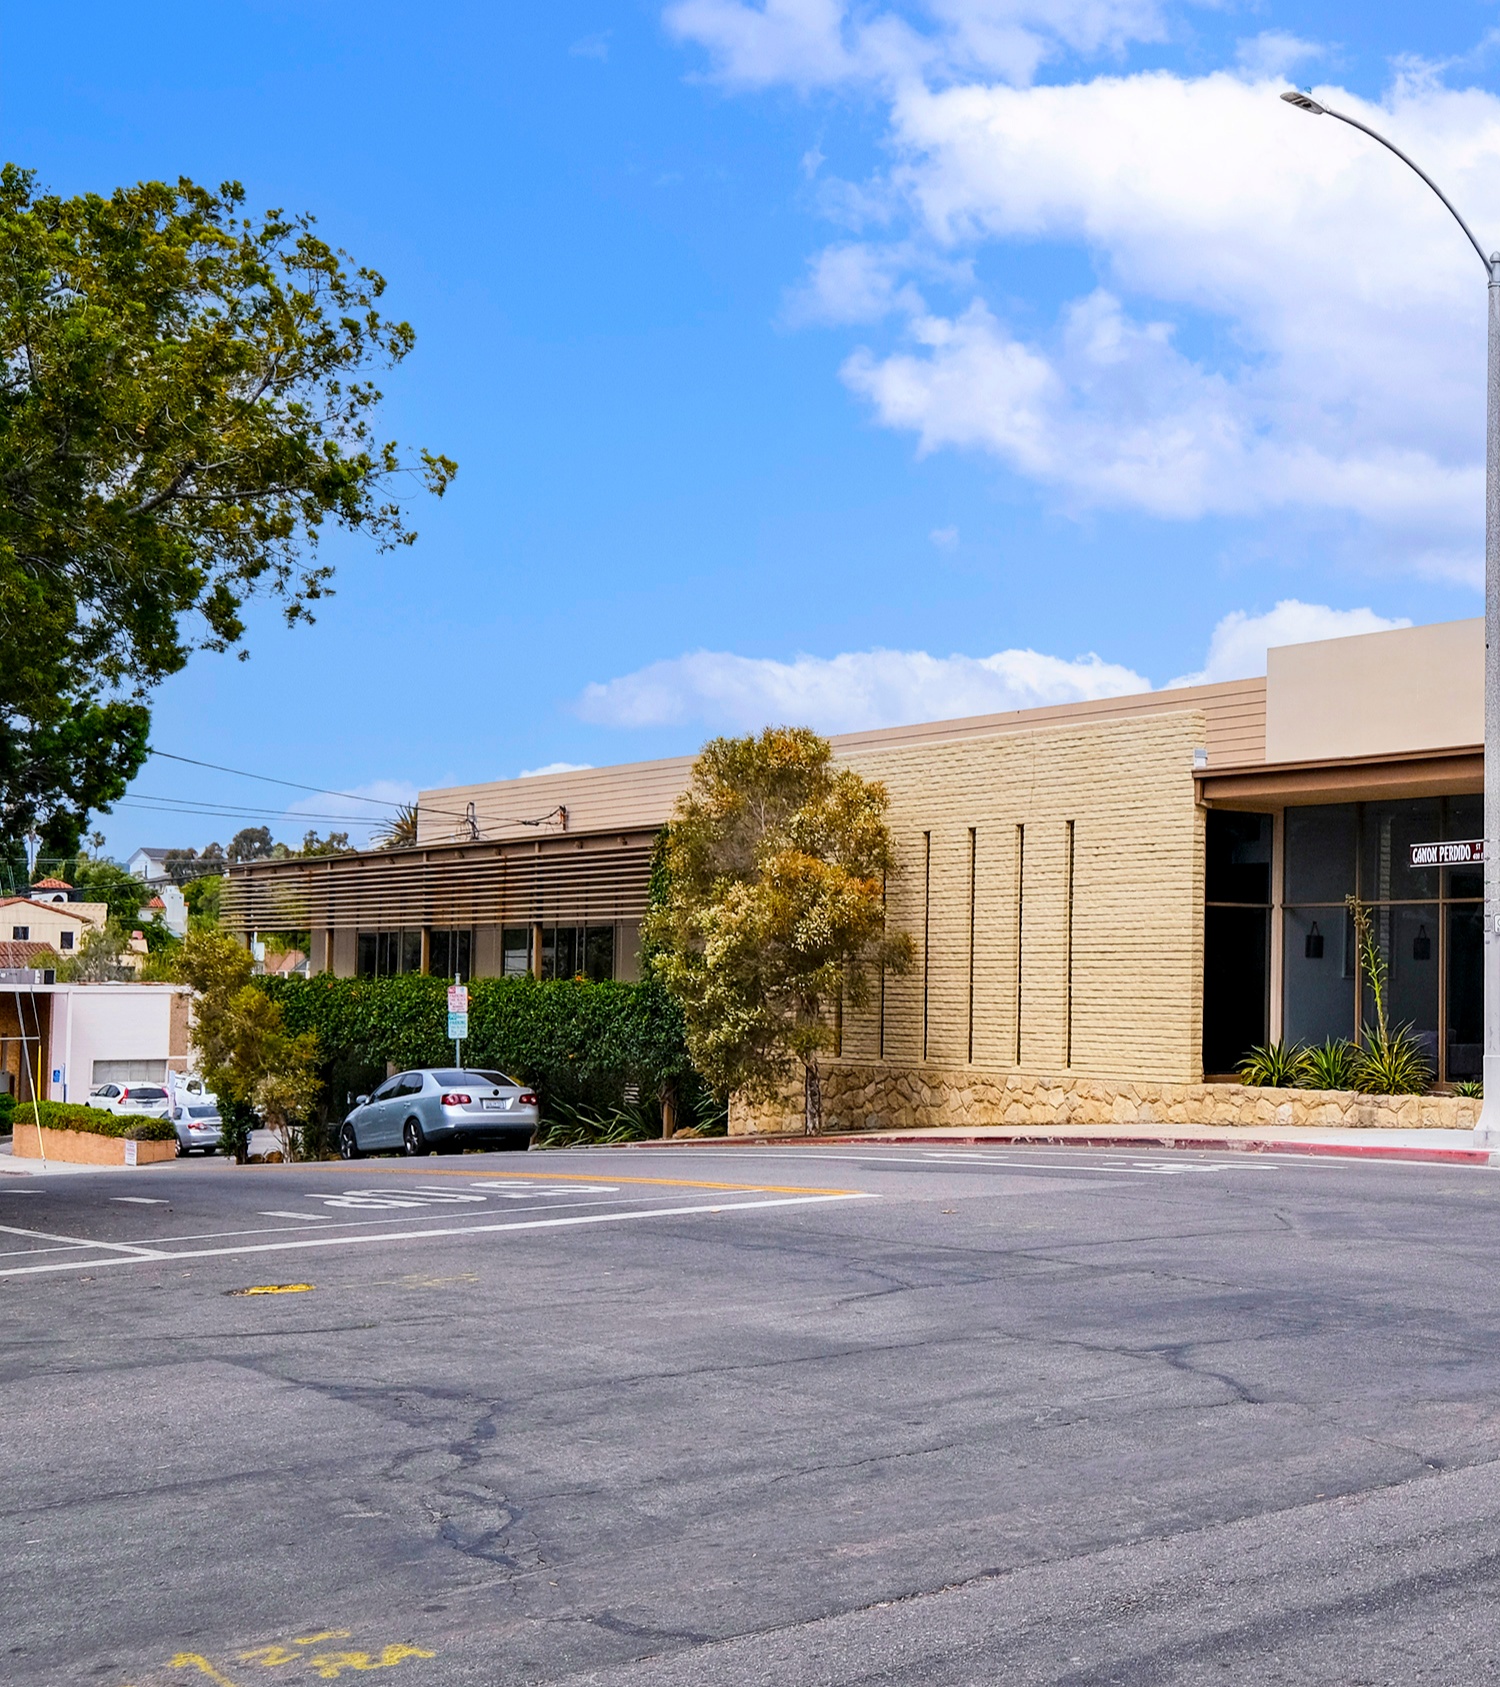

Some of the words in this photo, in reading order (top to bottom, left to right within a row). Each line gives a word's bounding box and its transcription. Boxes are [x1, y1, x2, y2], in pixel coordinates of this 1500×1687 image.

[1412, 847, 1438, 864] CANON
[1439, 844, 1471, 862] PERDIDO
[1475, 843, 1482, 851] ST
